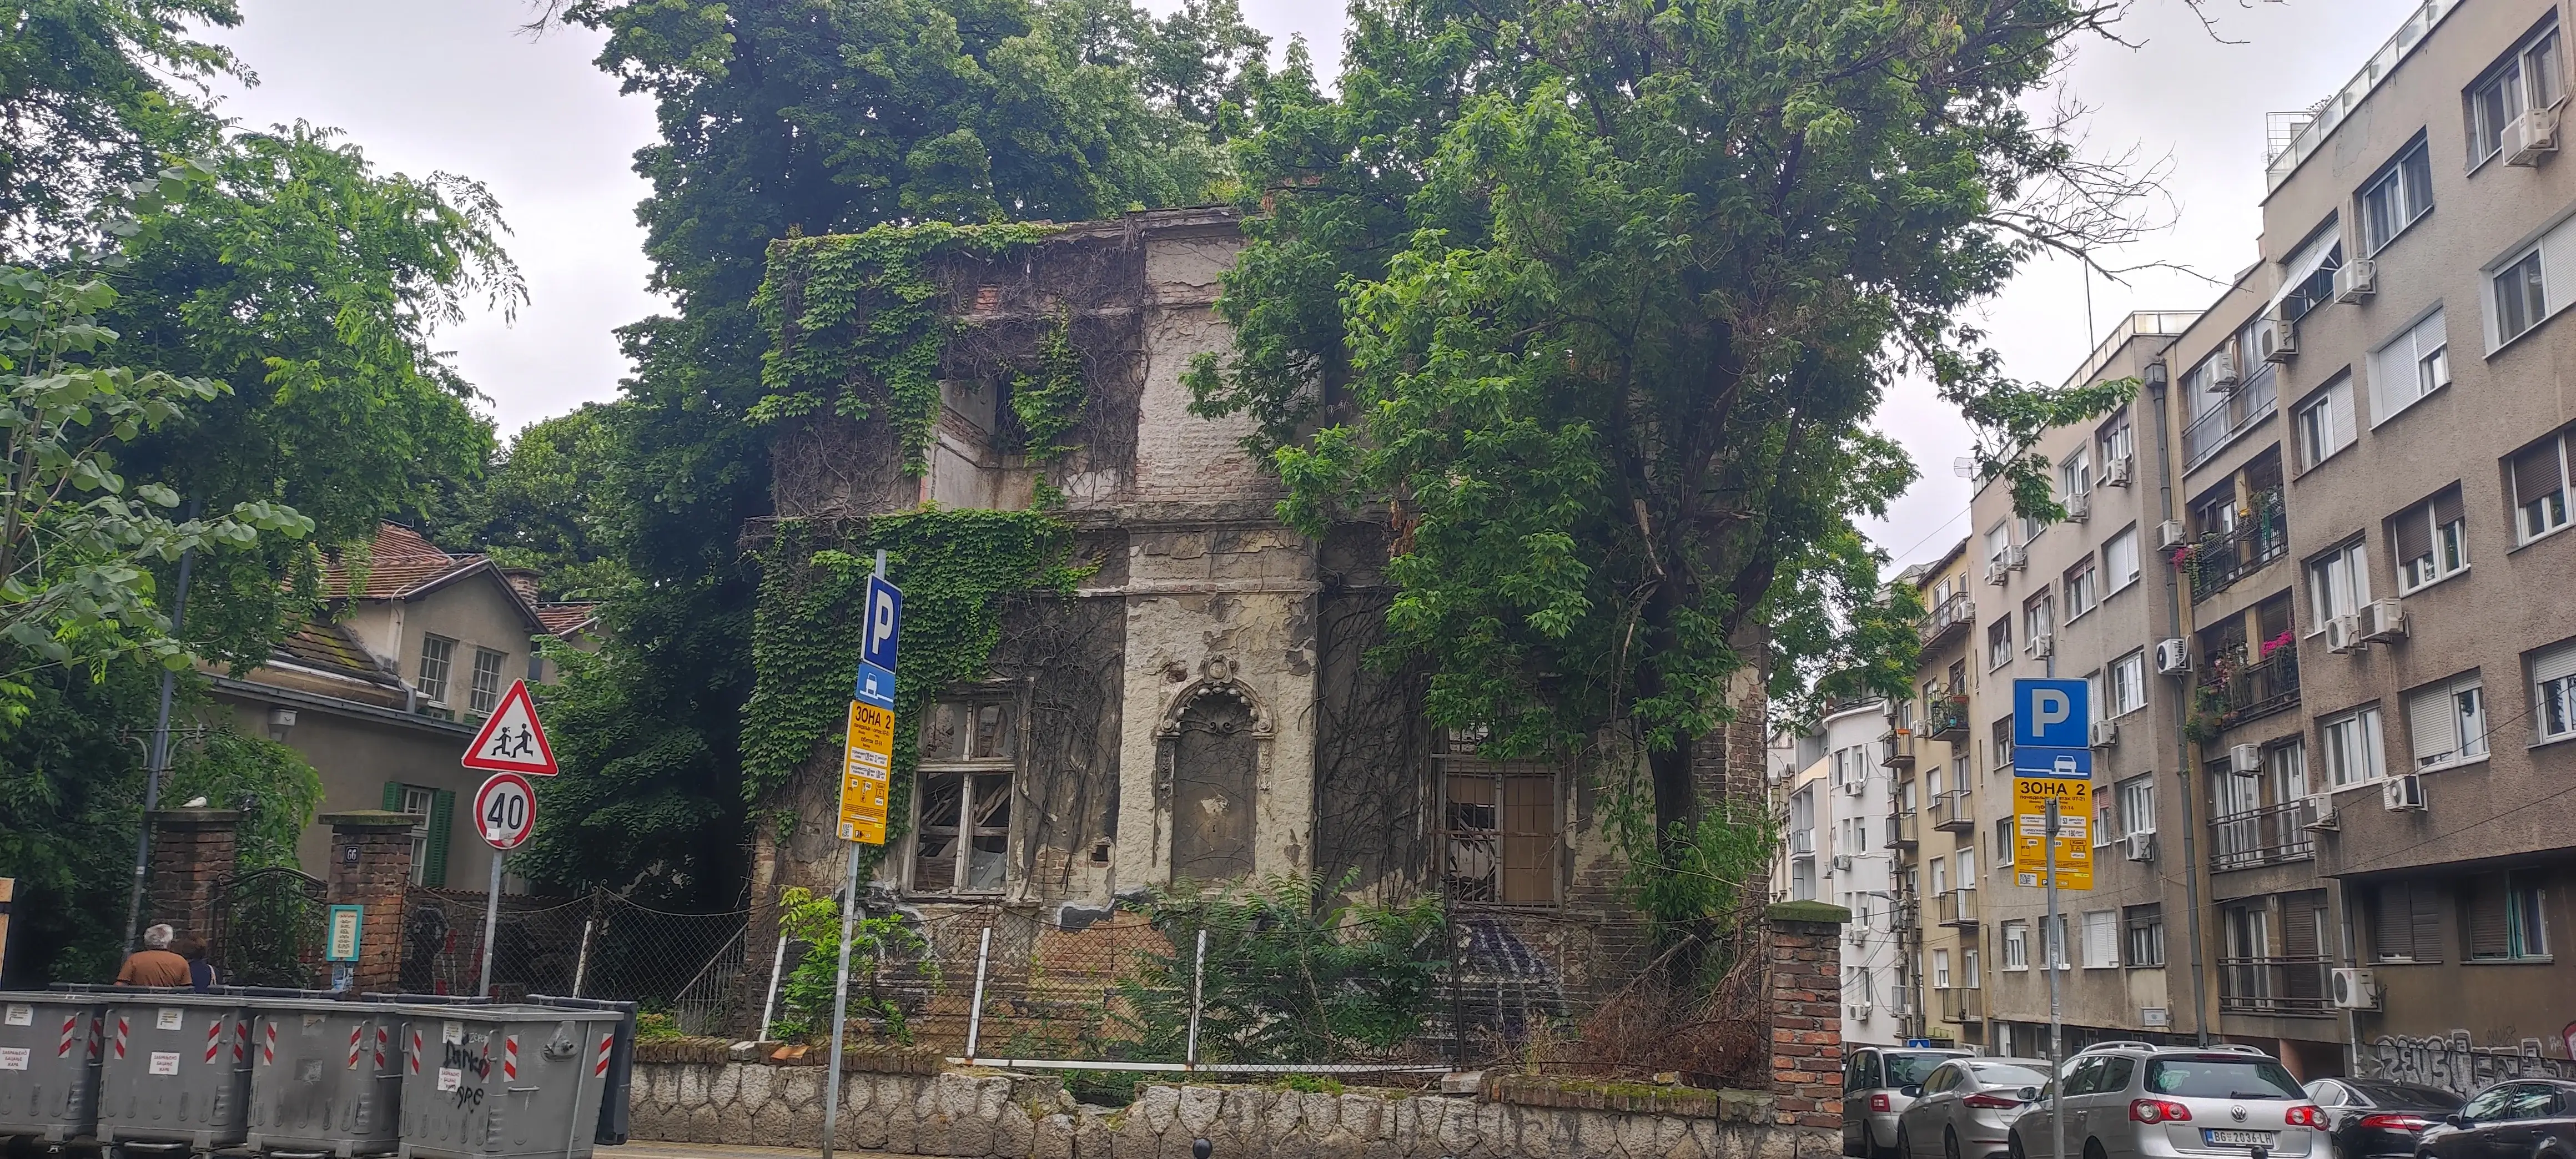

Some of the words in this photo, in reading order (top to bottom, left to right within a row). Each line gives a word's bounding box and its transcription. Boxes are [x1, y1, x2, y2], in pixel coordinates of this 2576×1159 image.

[872, 589, 894, 655] P
[856, 706, 881, 727] ЗОНА
[886, 715, 891, 729] 2
[2032, 689, 2070, 737] P
[2020, 782, 2067, 795] ЗОНА
[2076, 784, 2085, 795] 2
[487, 793, 525, 830] 40
[347, 849, 357, 860] 66
[2215, 1131, 2226, 1141] BG
